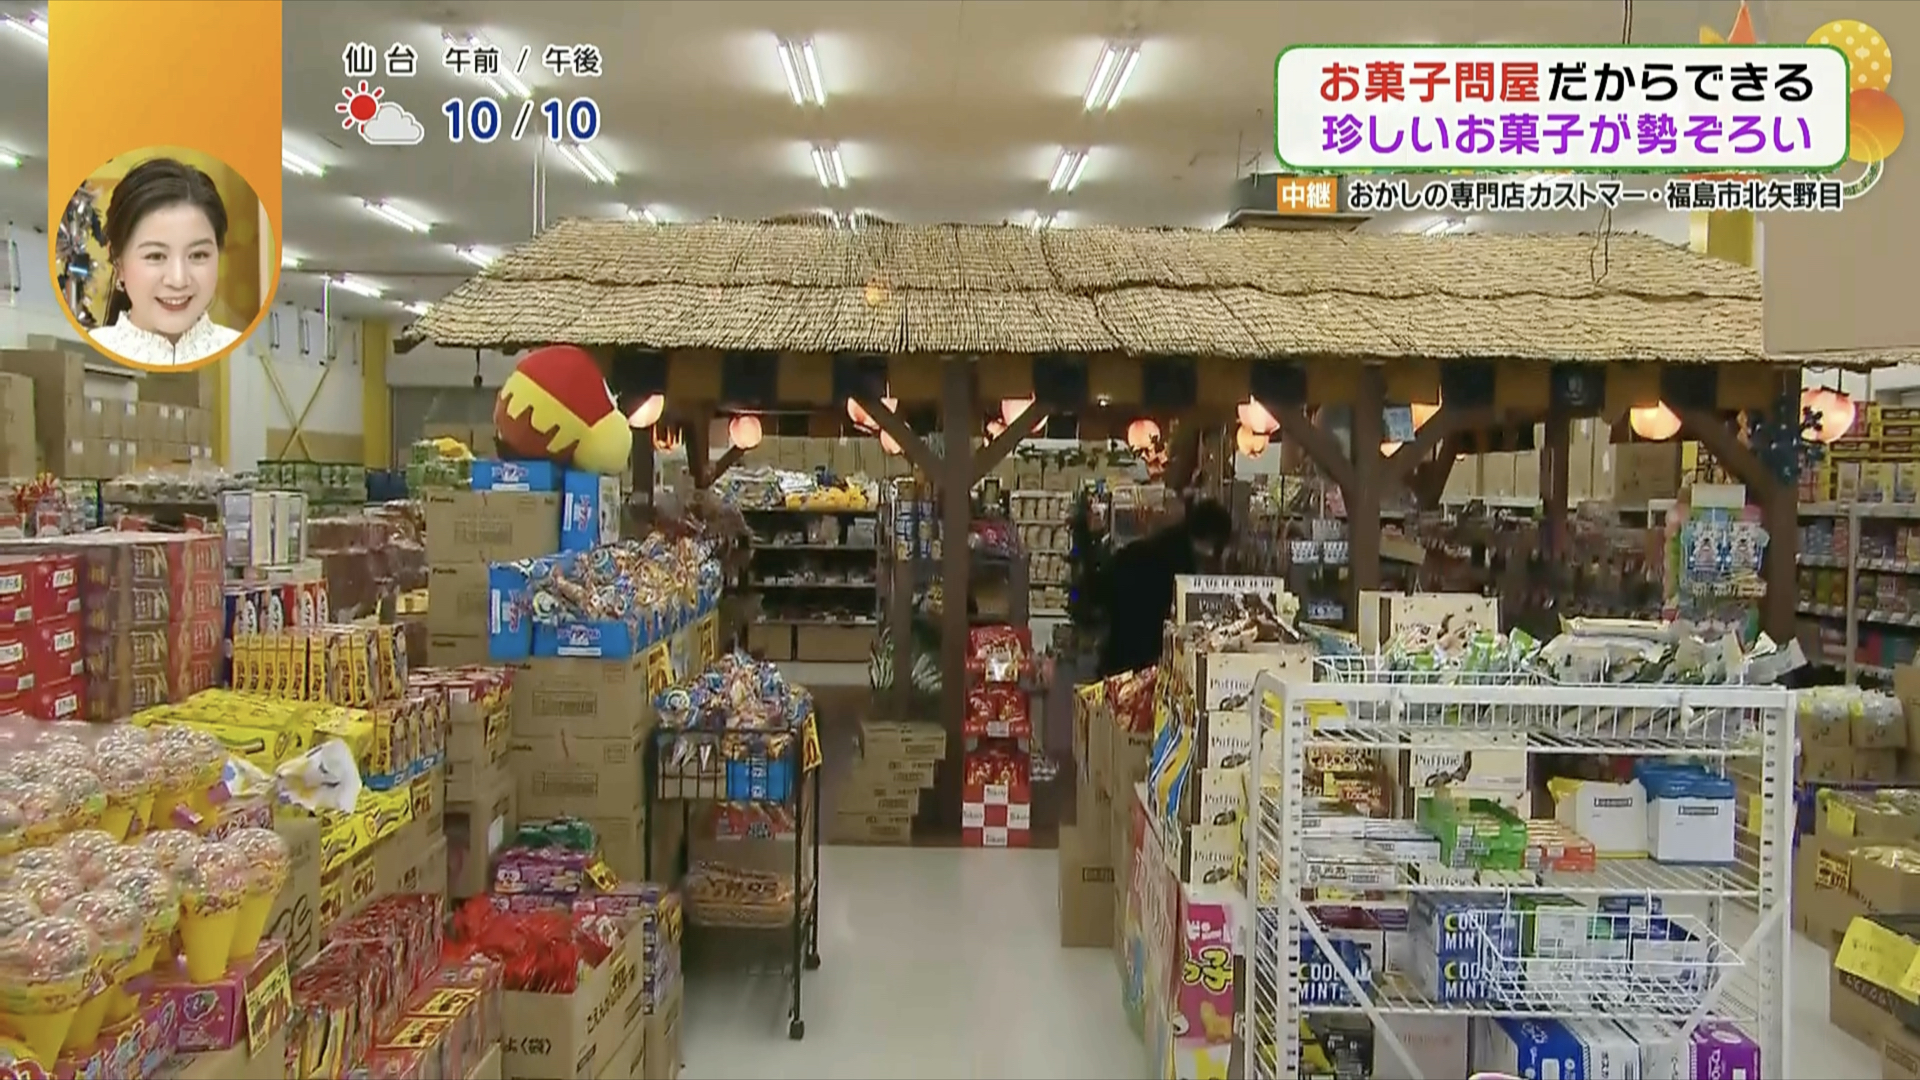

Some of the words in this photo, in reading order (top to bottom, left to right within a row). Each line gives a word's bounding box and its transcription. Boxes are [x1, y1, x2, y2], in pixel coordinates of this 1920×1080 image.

[1444, 912, 1479, 931] COO
[1445, 931, 1475, 950] MIN
[1444, 961, 1481, 980] COO
[1299, 982, 1339, 1000] MINT
[1445, 981, 1487, 999] MINT
